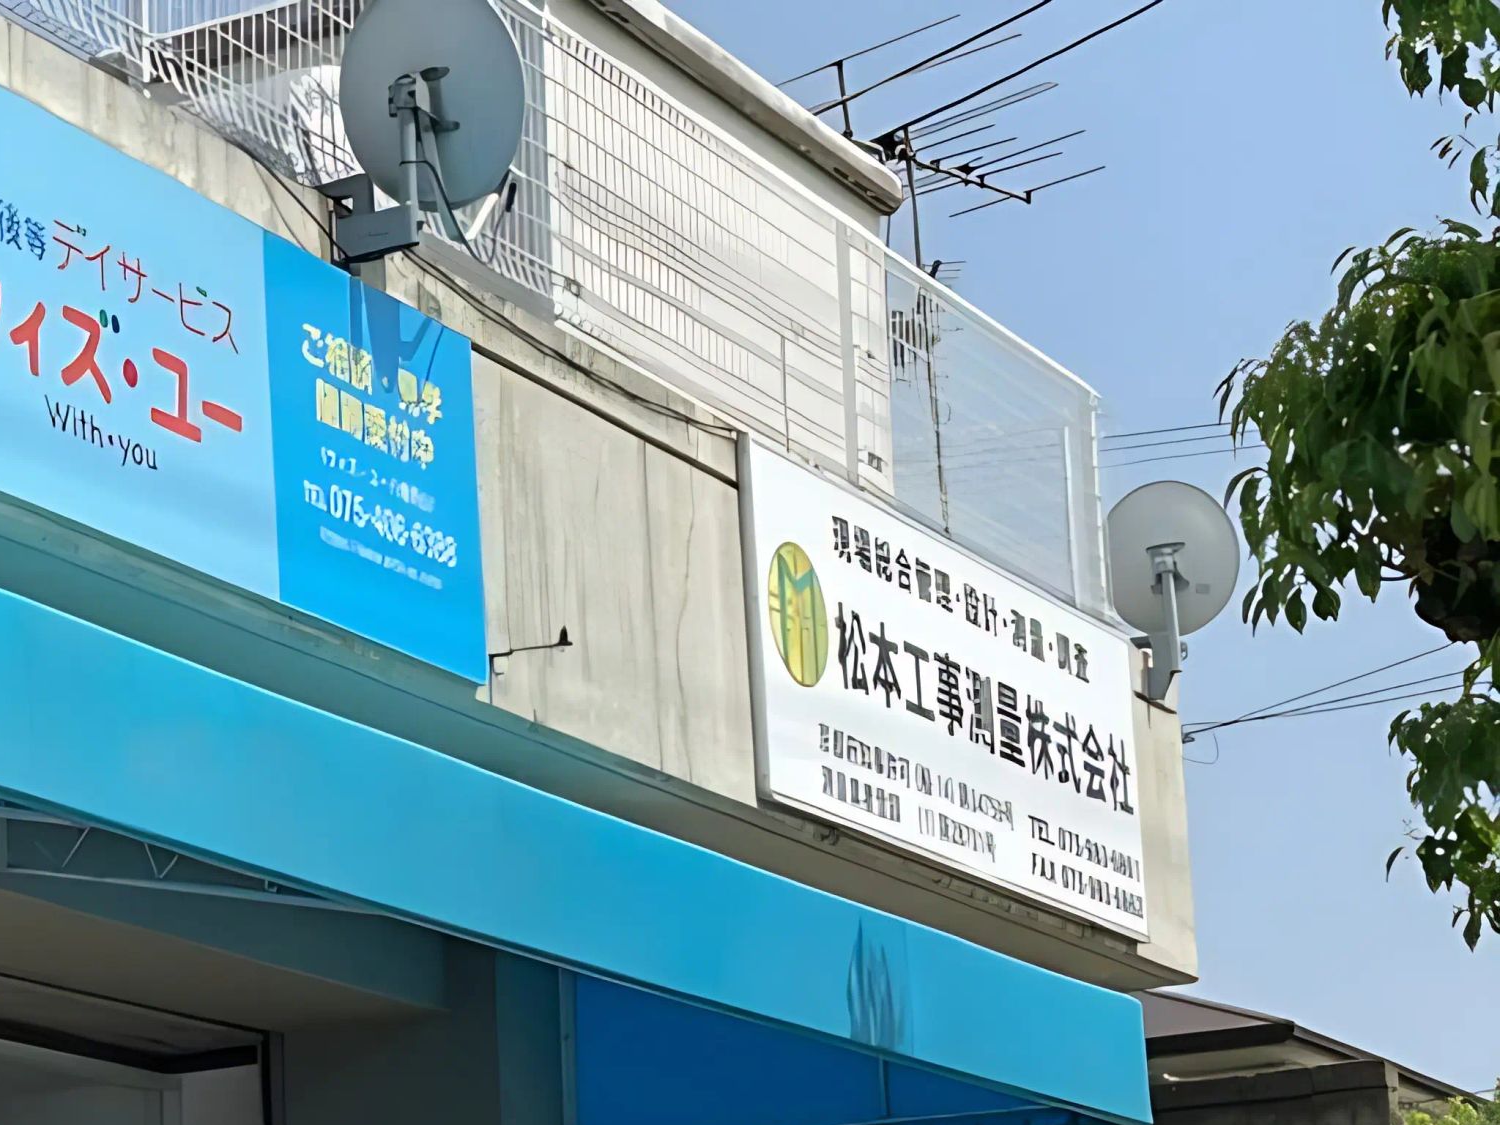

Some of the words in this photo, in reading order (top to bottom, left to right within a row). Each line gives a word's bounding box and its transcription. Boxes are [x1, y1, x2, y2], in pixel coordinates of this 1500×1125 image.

[834, 600, 1134, 815] 松本工事測量株式会社
